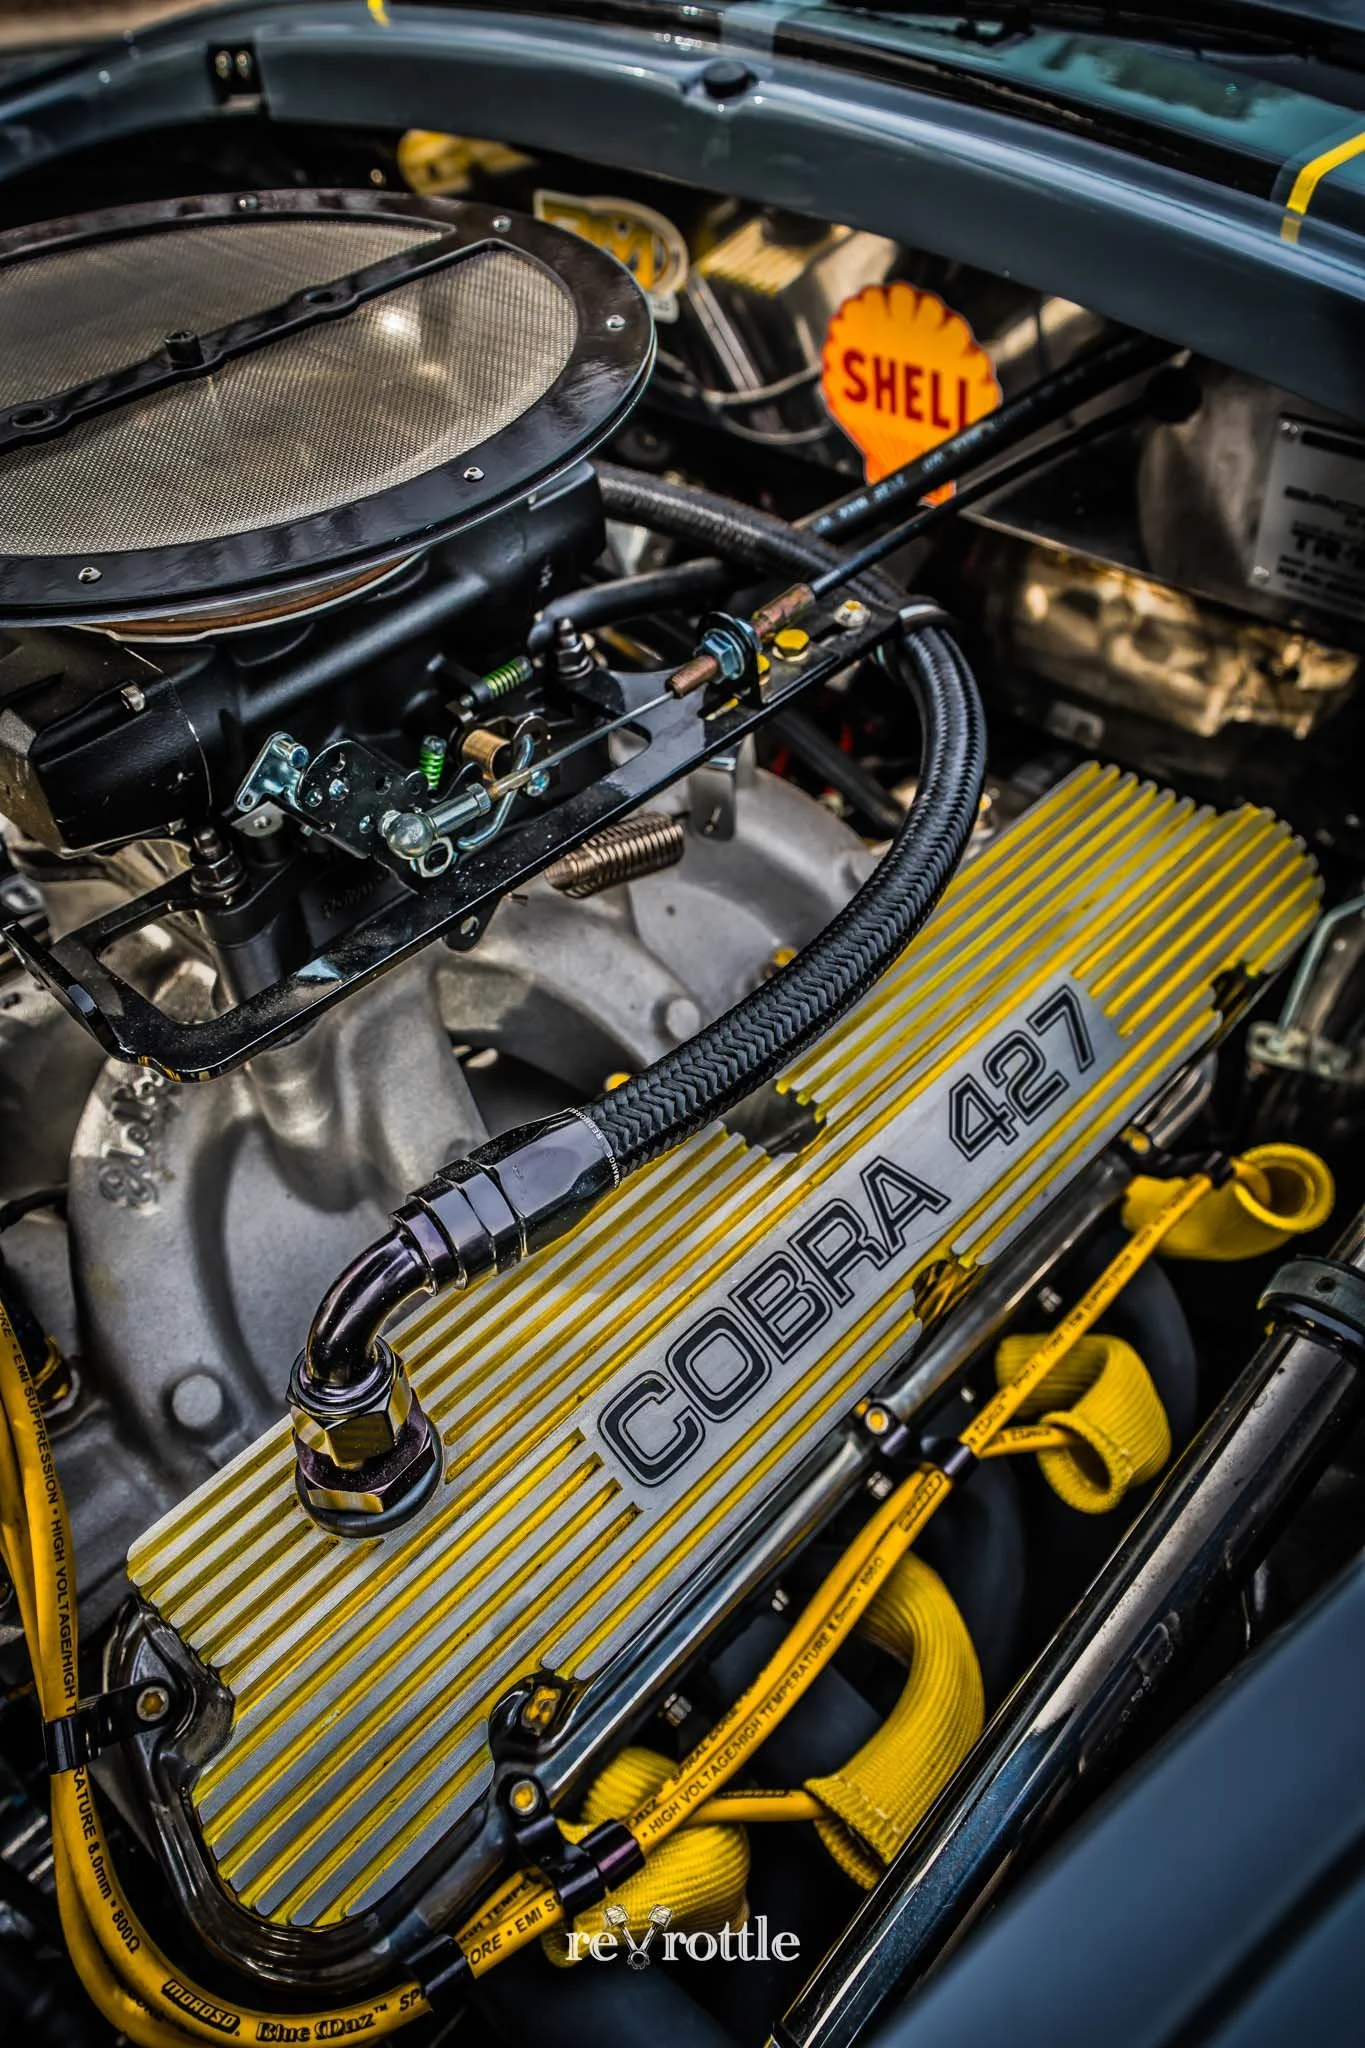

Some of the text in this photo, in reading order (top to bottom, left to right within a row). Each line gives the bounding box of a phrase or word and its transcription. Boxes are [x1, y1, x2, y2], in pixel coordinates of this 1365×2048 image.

[597, 985, 1095, 1488] COBRA 427
[13, 1353, 31, 1384] EMI
[24, 1385, 58, 1505] SUPPRESSION
[51, 1520, 65, 1562] HIGH
[648, 1803, 681, 1834] HIGH
[514, 1907, 544, 1934] EMI
[256, 2021, 310, 2042] Blue
